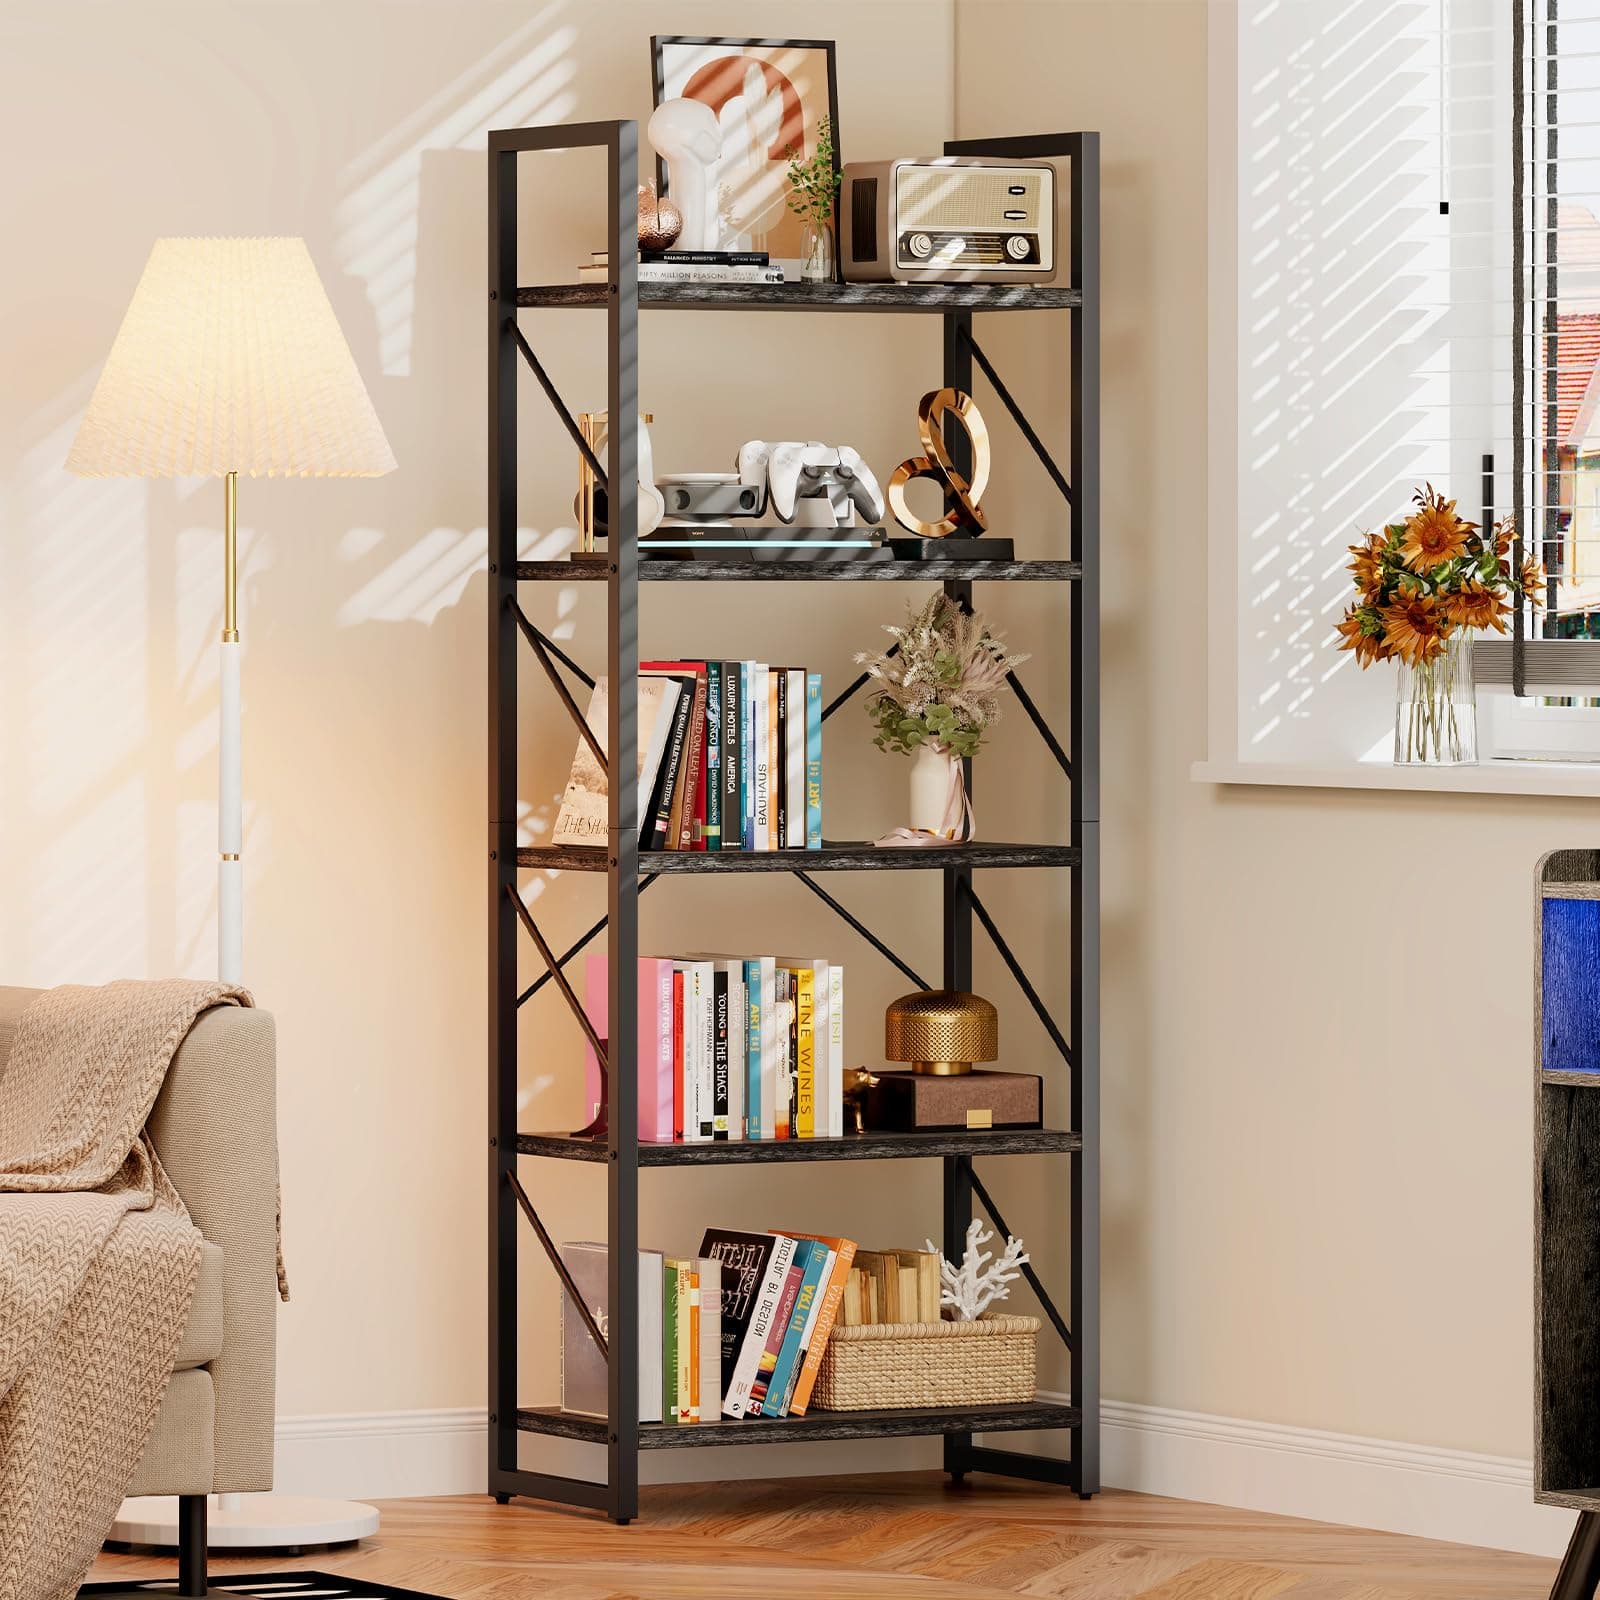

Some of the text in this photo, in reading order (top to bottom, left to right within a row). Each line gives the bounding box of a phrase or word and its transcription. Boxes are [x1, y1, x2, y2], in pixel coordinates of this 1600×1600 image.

[660, 271, 691, 279] MILLION
[693, 271, 727, 280] REASONS
[680, 694, 691, 714] POWER
[676, 714, 687, 740] QUALITY
[690, 687, 706, 777] CRUMBLED OAK LEAF
[727, 675, 735, 794] LUXURY HOTELS AMERICA
[668, 745, 680, 777] ELECTRICAL
[663, 777, 674, 806] SYSTEMS
[758, 764, 767, 826] BAUHAUS
[809, 781, 820, 809] ART
[563, 814, 584, 834] THE
[661, 978, 670, 1061] LUXURY FOR CATS
[751, 1003, 760, 1030] ART
[832, 1012, 840, 1045] FISH
[717, 993, 727, 1102] YOUNG THE SHACK
[801, 993, 811, 1115] FINE WINES
